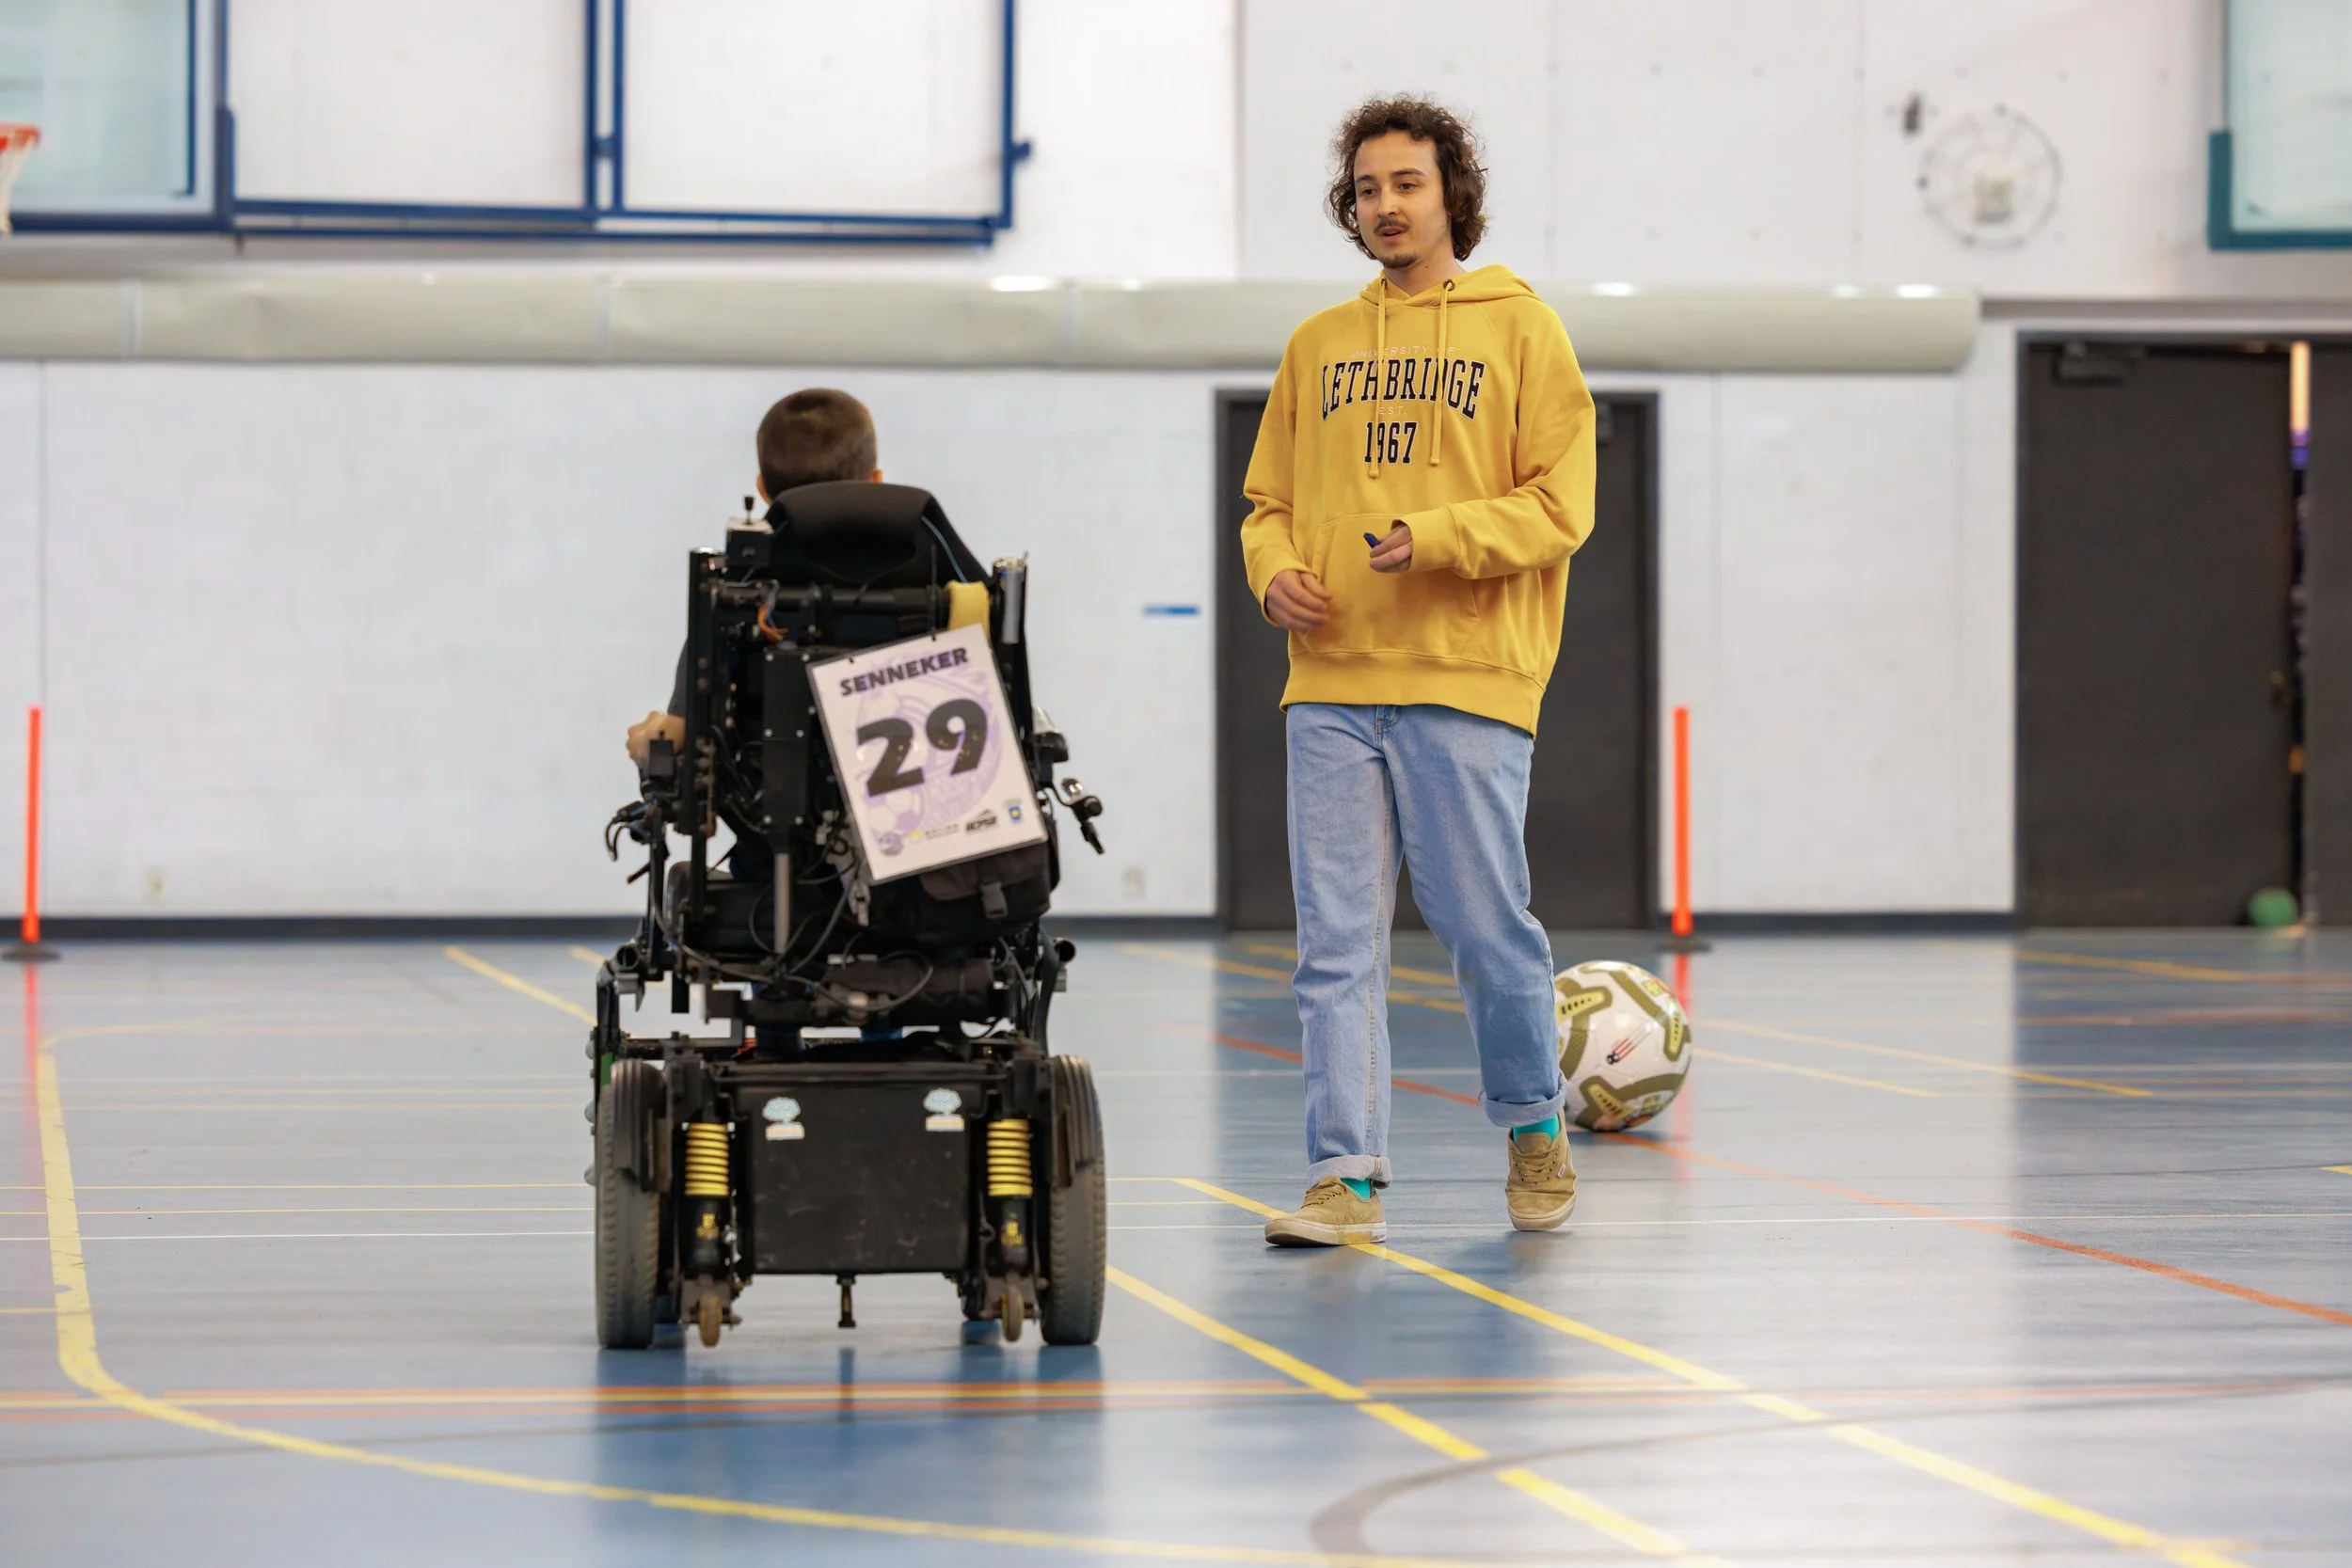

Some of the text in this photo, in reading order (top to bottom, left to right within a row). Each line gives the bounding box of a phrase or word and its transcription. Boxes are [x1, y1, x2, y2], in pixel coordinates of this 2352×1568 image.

[1322, 357, 1486, 421] LETHBRIDGE
[1363, 420, 1418, 465] 1967
[839, 647, 969, 696] SENNEKER
[856, 698, 988, 798] 29
